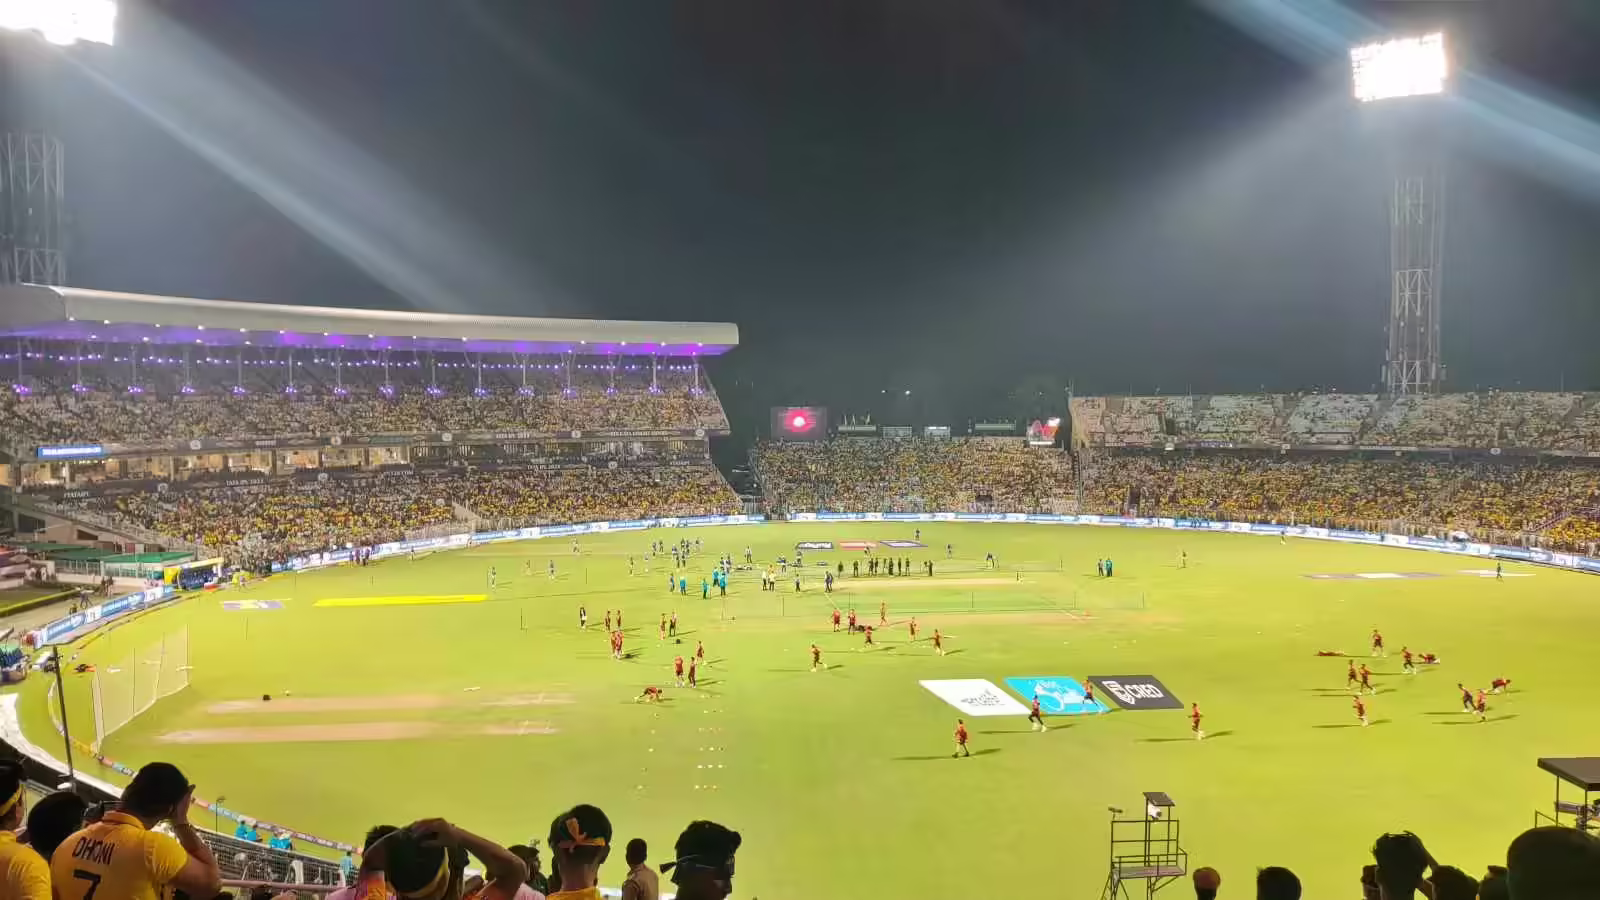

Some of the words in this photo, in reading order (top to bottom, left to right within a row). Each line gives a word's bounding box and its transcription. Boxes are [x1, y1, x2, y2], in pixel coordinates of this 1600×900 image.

[1123, 684, 1165, 698] CRED
[72, 836, 116, 865] DHONI
[73, 869, 102, 900] 7
